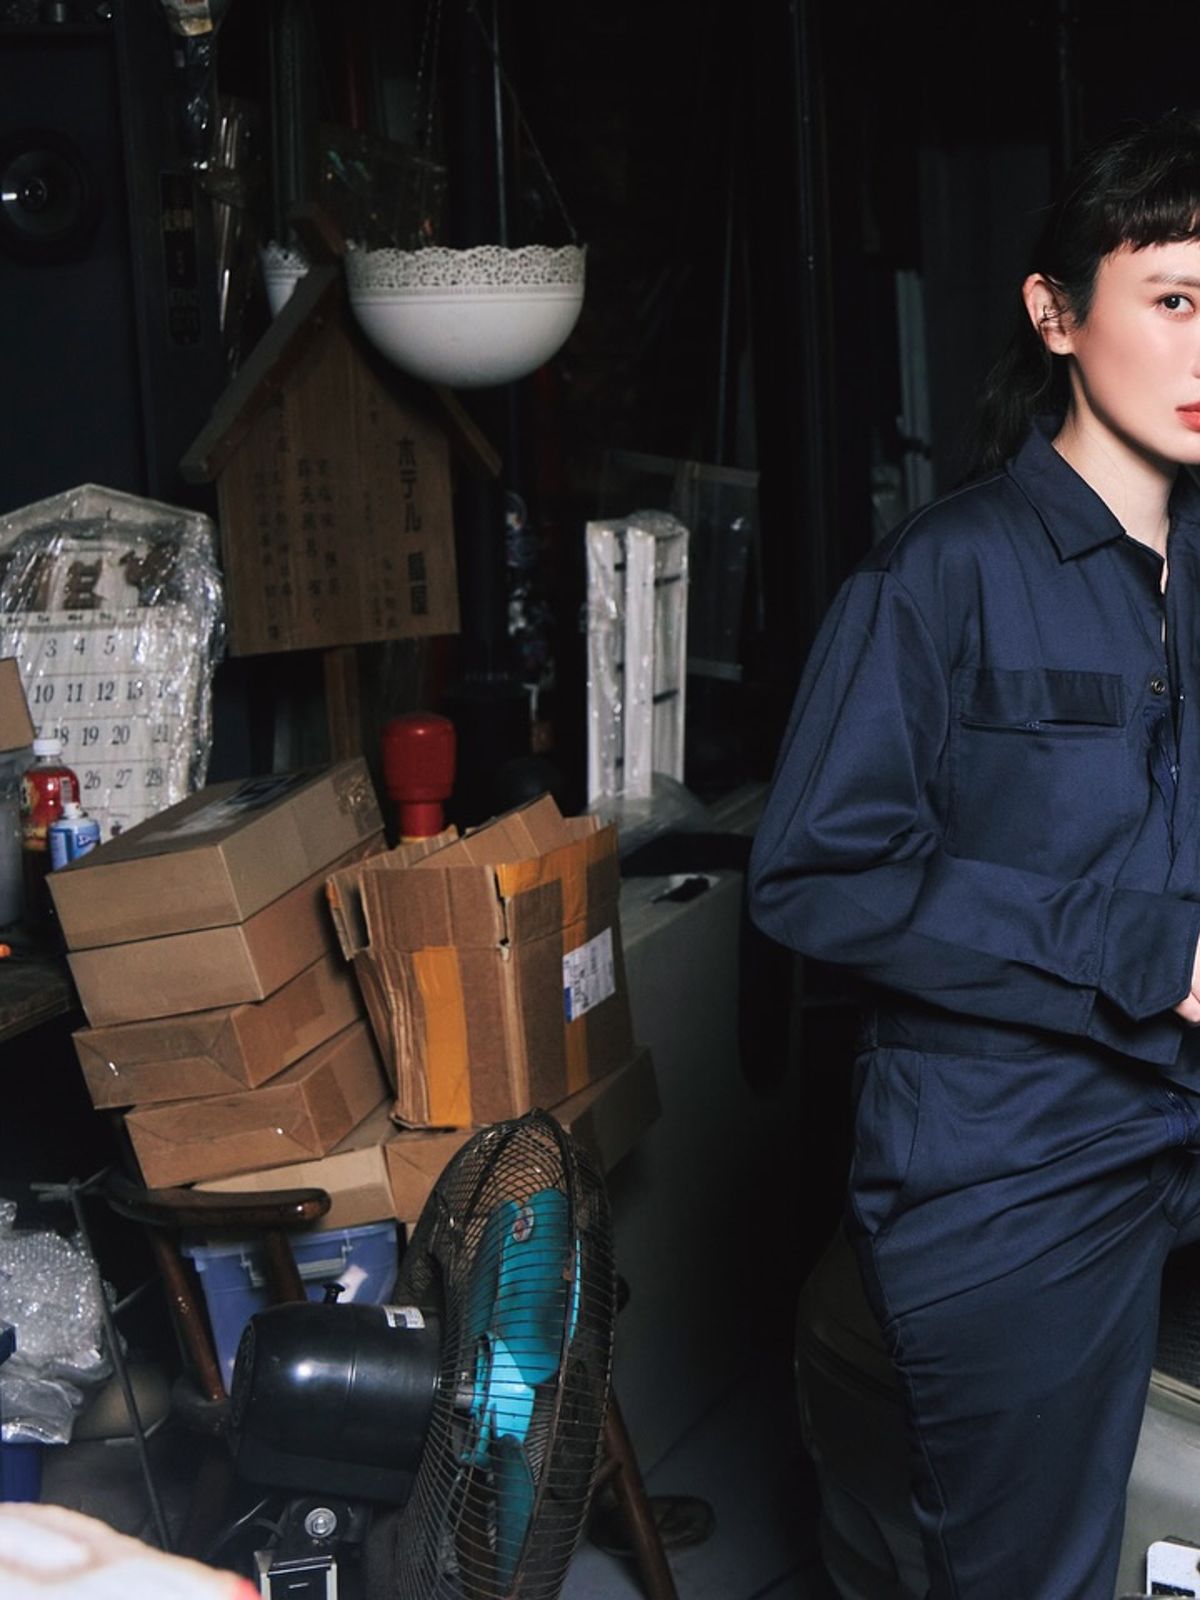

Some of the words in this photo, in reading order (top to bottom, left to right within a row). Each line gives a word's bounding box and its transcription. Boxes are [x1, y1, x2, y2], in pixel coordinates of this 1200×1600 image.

[45, 638, 58, 658] 3
[74, 637, 86, 656] 4
[103, 634, 116, 656] 5
[34, 683, 55, 704] 10
[67, 682, 83, 703] 11
[97, 680, 115, 702] 12
[126, 680, 144, 701] 13
[53, 725, 70, 747] 18
[82, 726, 100, 747] 19
[112, 724, 131, 745] 20
[152, 723, 169, 743] 21
[83, 770, 101, 790] 26
[115, 768, 133, 789] 27
[145, 767, 163, 788] 28
